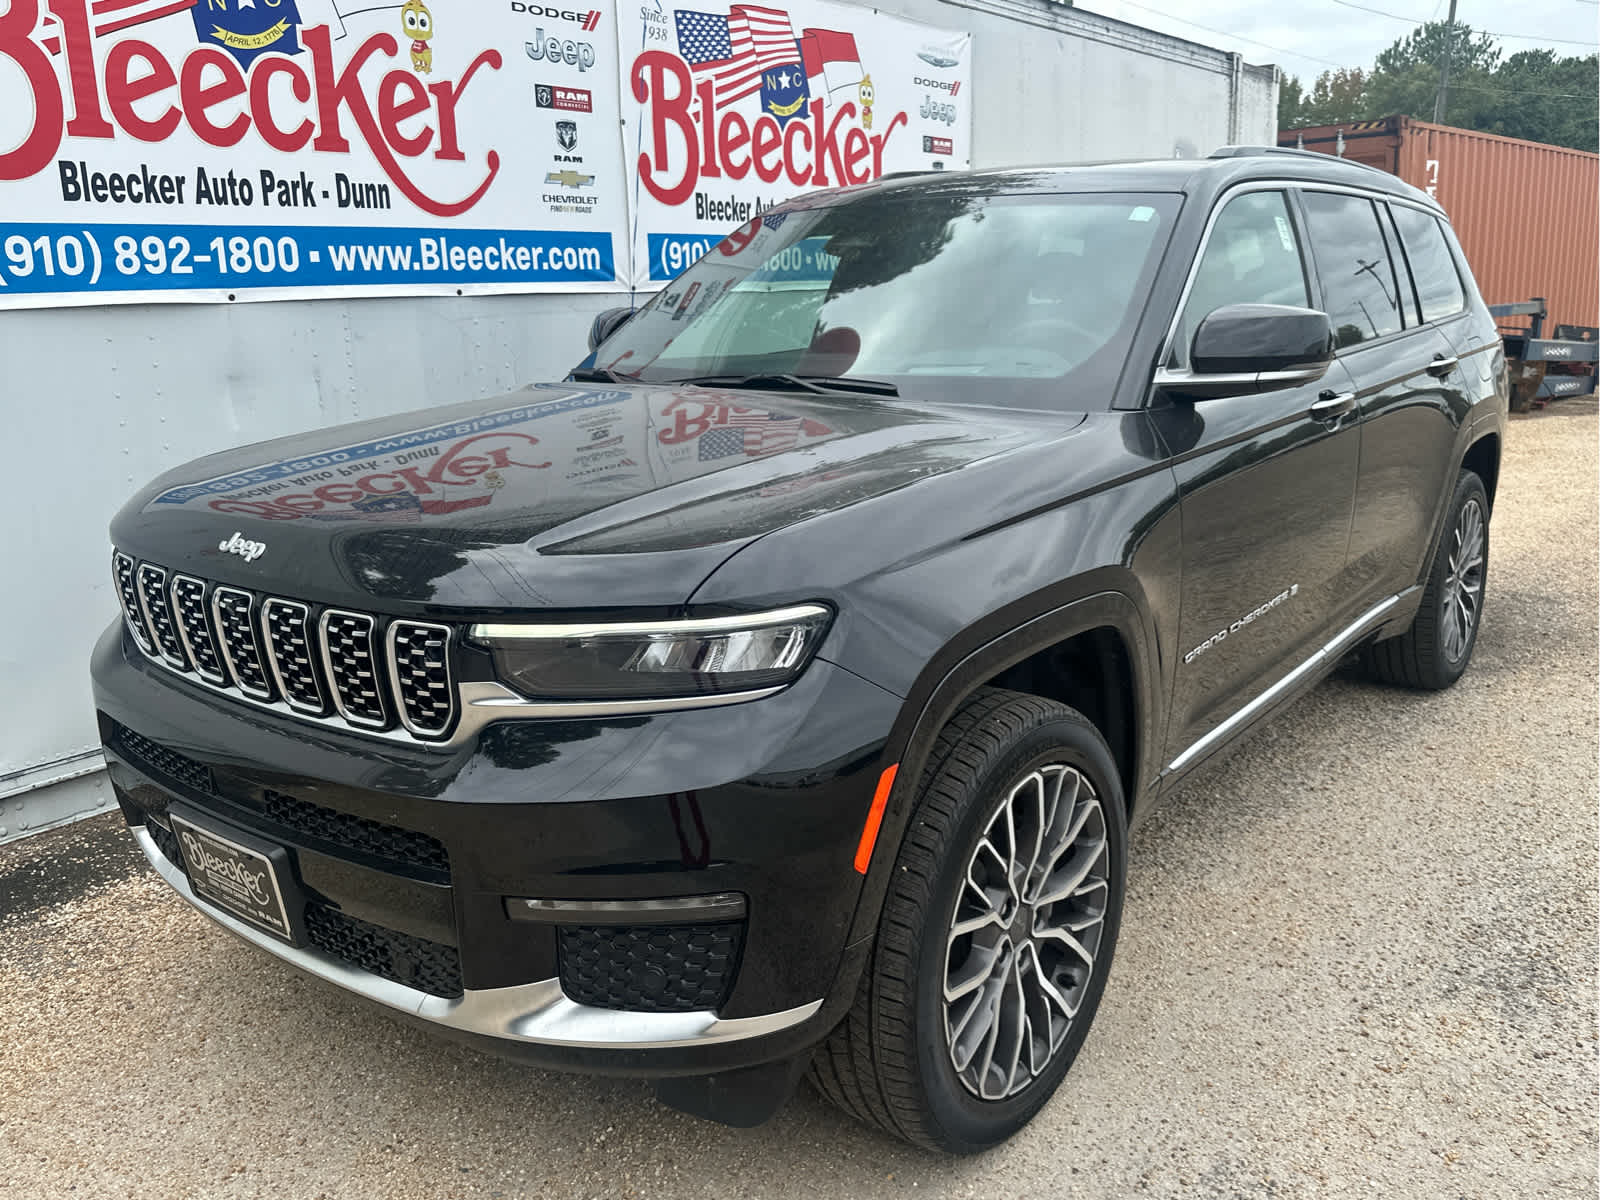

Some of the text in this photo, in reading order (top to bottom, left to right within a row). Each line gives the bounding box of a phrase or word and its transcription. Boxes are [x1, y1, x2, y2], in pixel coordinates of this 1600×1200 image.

[511, 2, 590, 23] DODGE
[640, 6, 668, 24] Since
[227, 35, 251, 46] APRIL
[643, 26, 668, 41] 938
[525, 27, 595, 72] Jeep
[555, 90, 589, 102] RAM
[913, 77, 955, 91] DODGE
[920, 94, 956, 127] Jeep
[631, 50, 908, 206] Bleecker
[554, 154, 583, 163] RAM
[58, 160, 186, 204] Bleecker
[195, 166, 253, 206] Auto
[260, 169, 317, 207] Park
[335, 173, 391, 209] Dunn
[542, 194, 598, 204] CHEVROLET
[696, 192, 751, 222] Bleecker
[113, 235, 300, 275] 892-1800
[327, 237, 601, 271] www.Bleecker.com
[219, 532, 266, 562] Jeep
[182, 832, 269, 905] Bleecker
